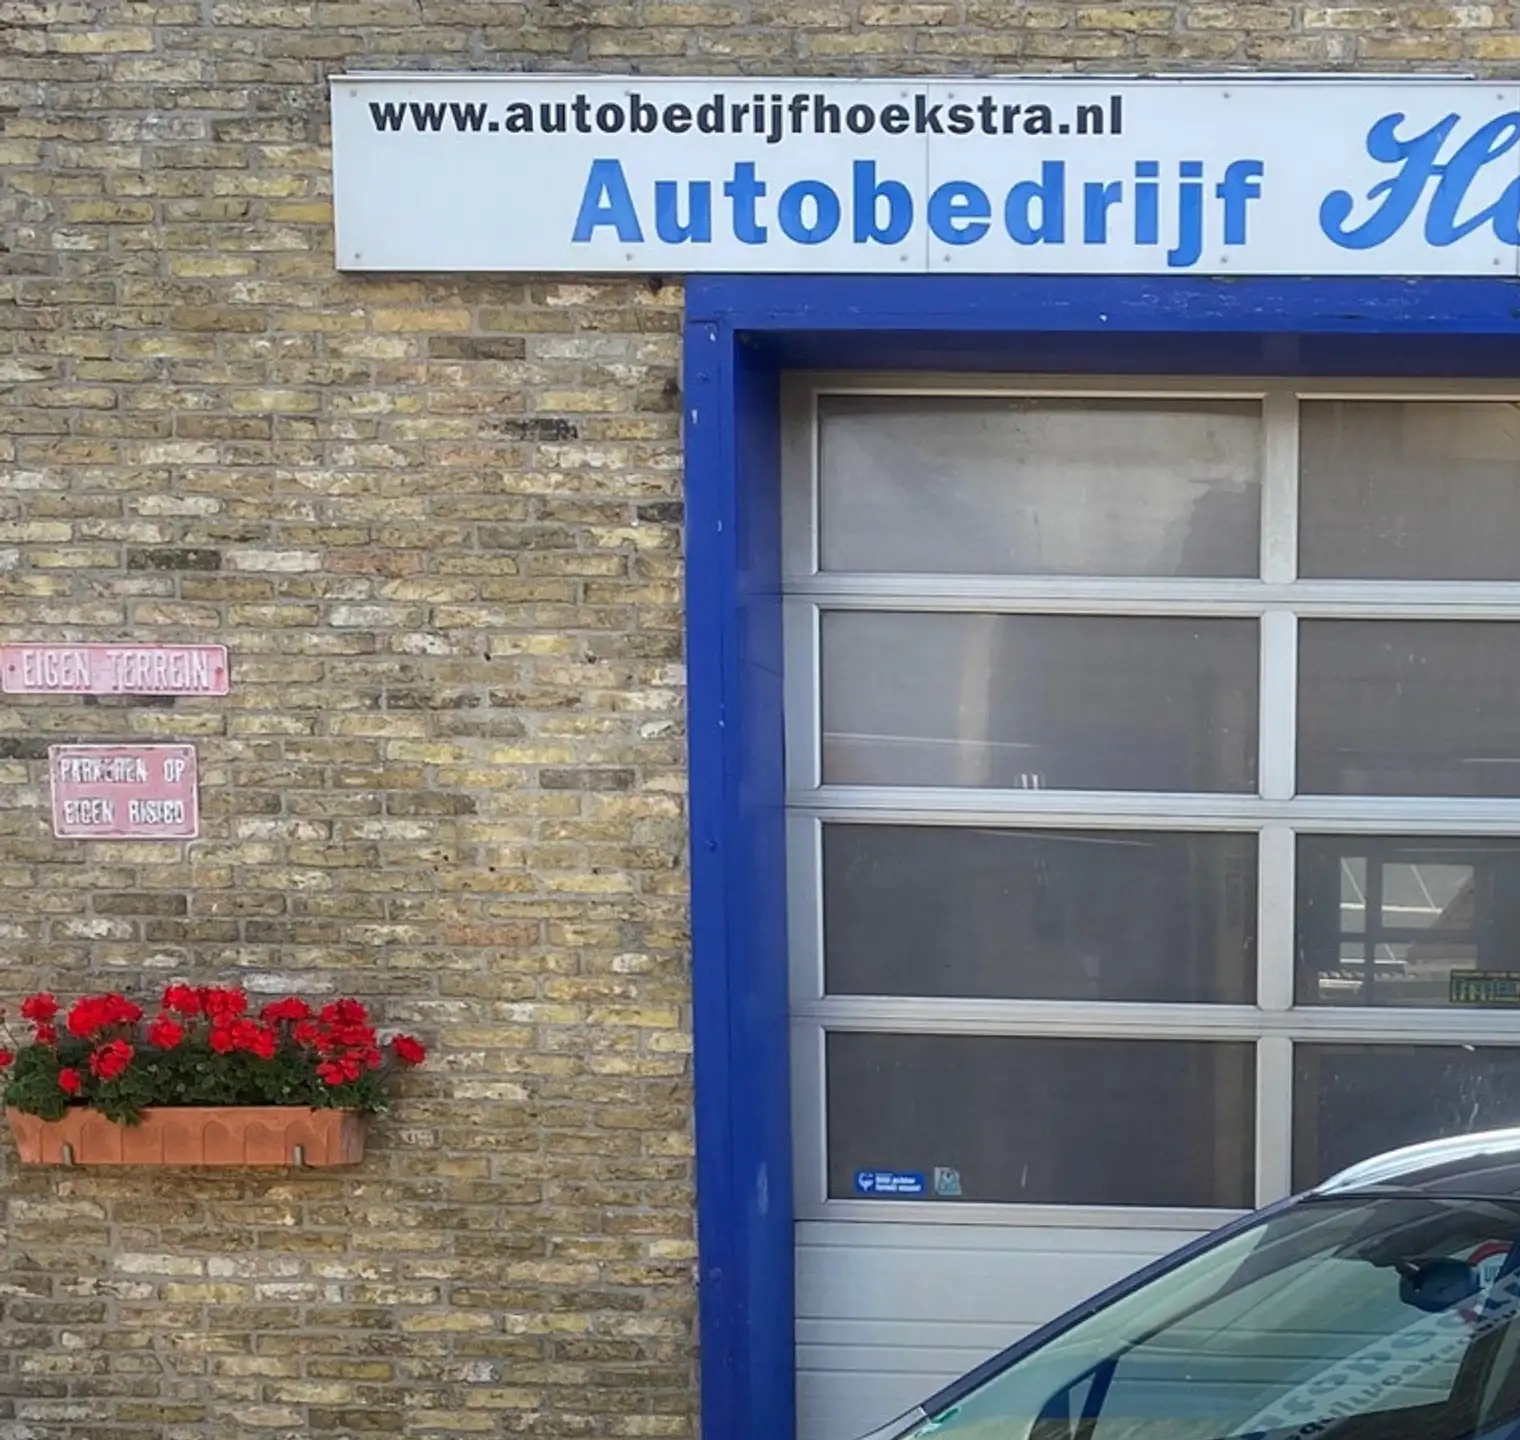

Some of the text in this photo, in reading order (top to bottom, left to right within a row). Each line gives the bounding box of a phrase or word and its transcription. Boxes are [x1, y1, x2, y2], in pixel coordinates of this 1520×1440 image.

[369, 94, 1124, 144] www.autobedrijfhoekstra.nl
[571, 158, 1264, 267] Autobedrijf
[22, 650, 212, 691] EIGEN TERREIN
[163, 758, 185, 783] OP
[63, 799, 114, 824] EIGEN
